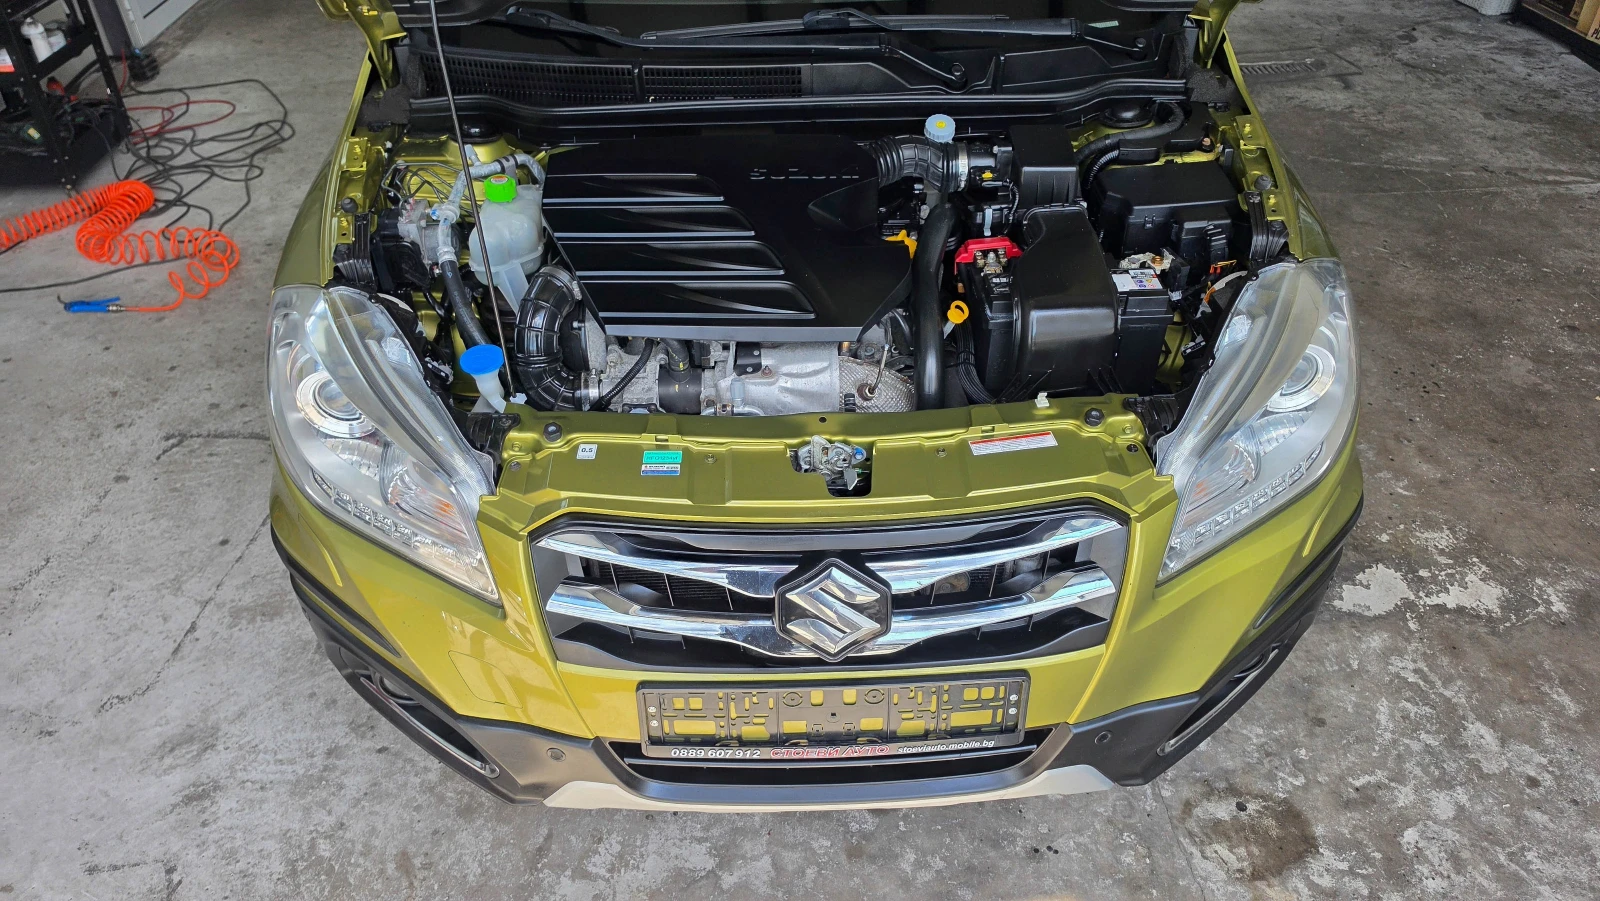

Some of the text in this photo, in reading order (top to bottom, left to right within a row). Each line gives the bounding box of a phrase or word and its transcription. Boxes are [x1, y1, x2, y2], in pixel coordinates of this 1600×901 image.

[897, 740, 995, 753] stoeviauto.mobile.bg
[670, 748, 761, 758] 0889 607 912
